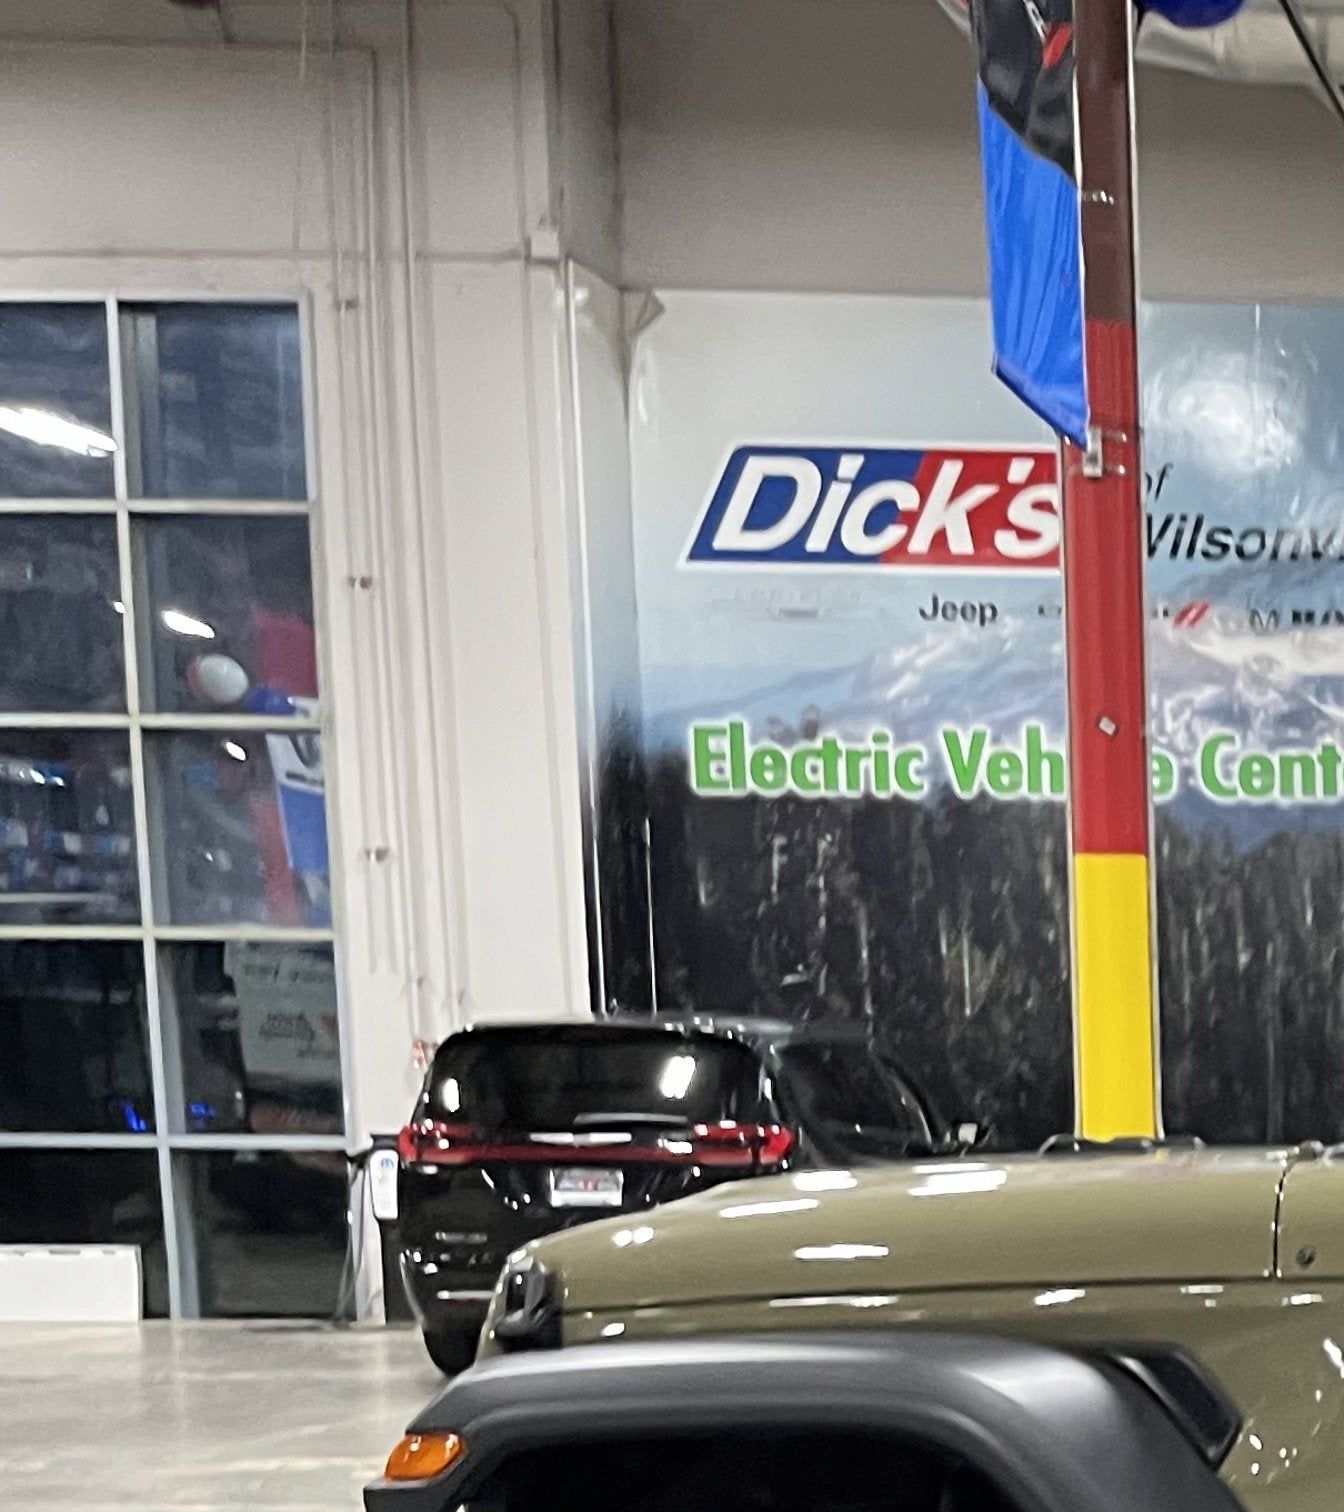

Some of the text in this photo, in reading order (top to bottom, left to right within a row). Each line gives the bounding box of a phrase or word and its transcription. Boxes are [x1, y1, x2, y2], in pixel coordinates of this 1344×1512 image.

[711, 453, 1061, 559] Dick's
[1145, 461, 1174, 501] f
[918, 593, 999, 627] Jeep
[692, 720, 926, 793] Electric
[941, 723, 1176, 796] Vehe
